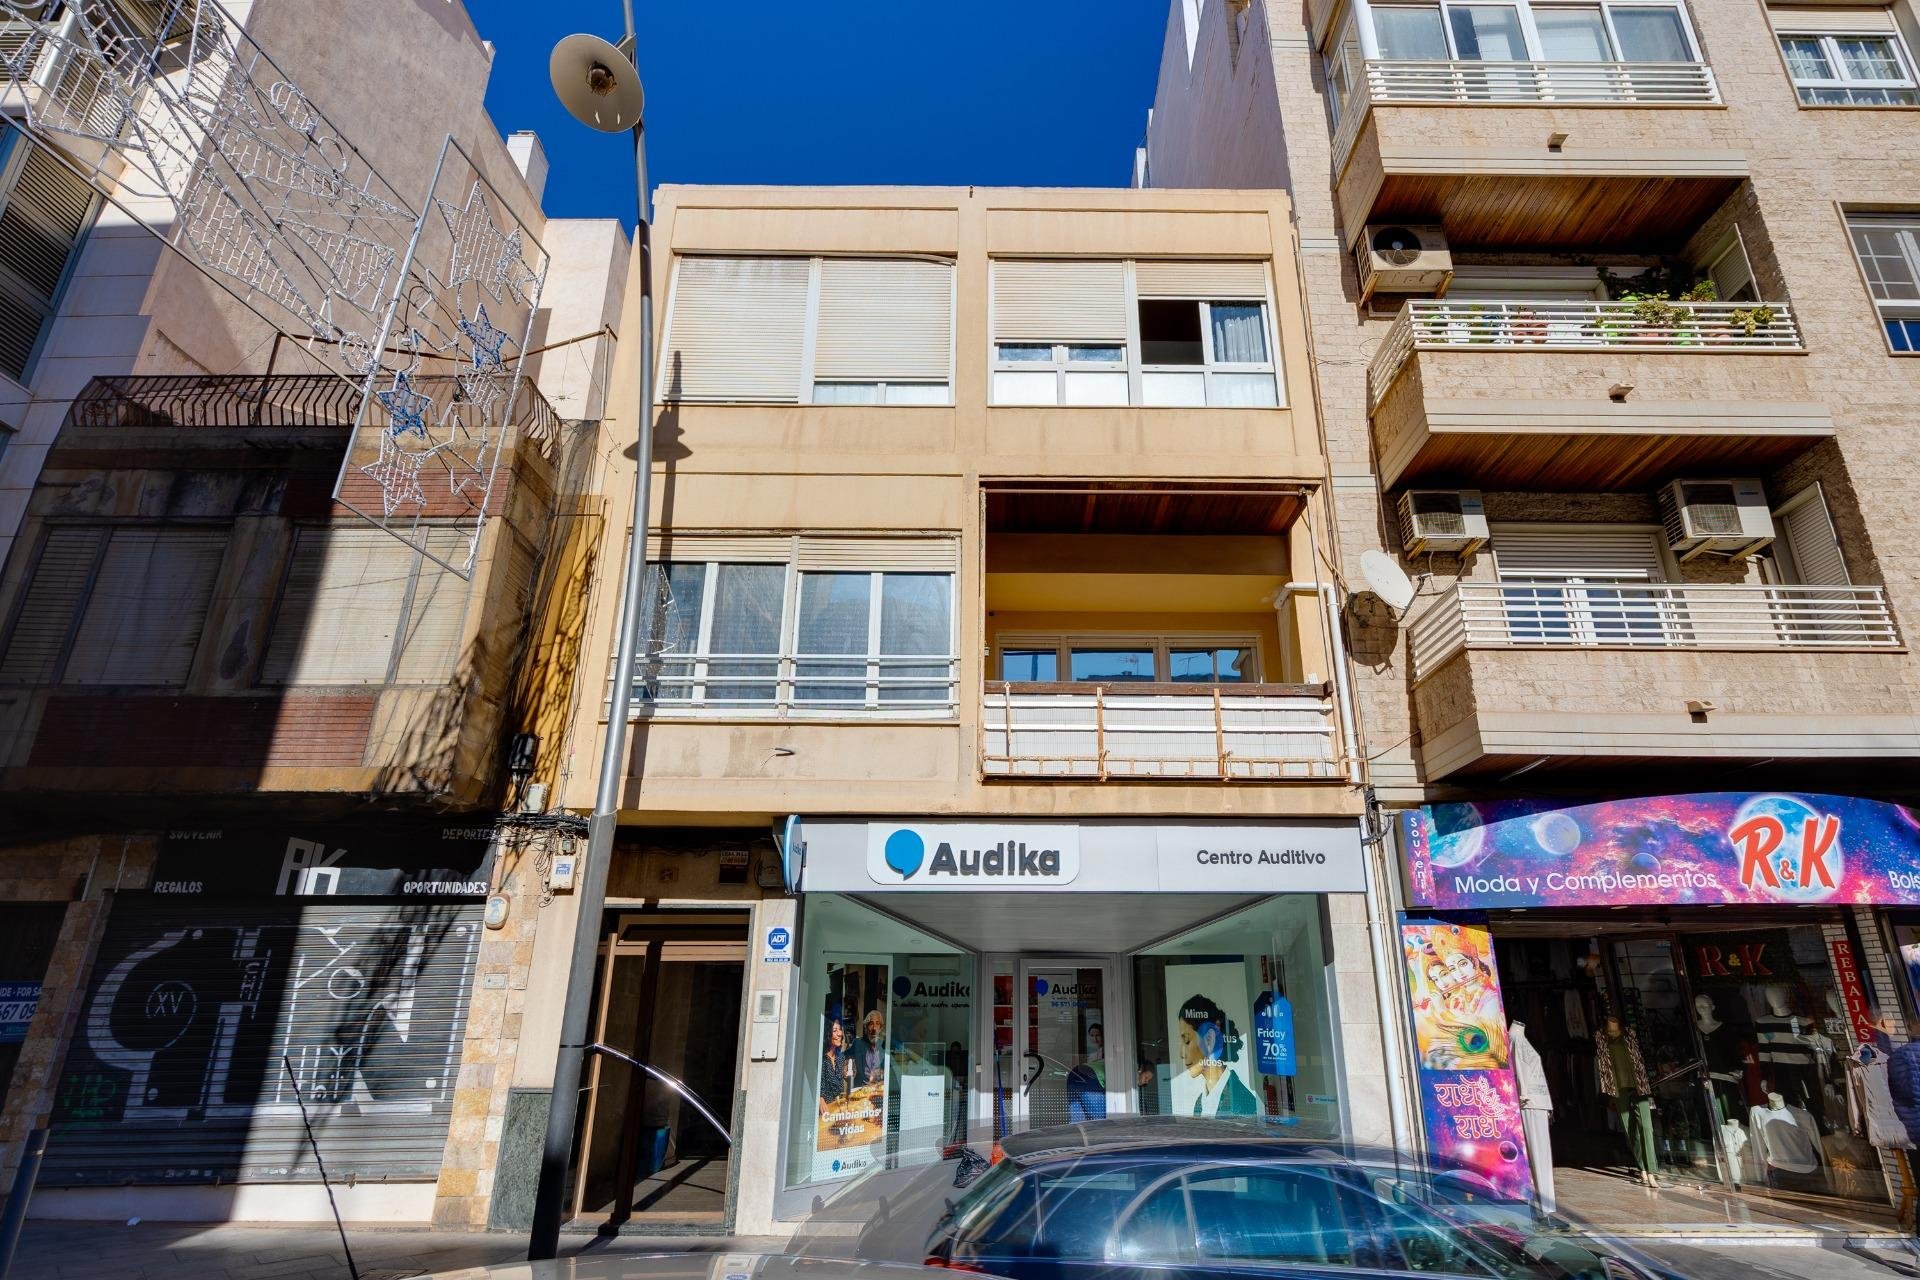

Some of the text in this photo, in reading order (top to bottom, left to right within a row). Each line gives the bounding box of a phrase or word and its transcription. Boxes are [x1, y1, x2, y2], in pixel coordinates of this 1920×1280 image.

[929, 840, 1060, 874] Audika
[1196, 849, 1326, 865] Centro Auditivo
[1410, 817, 1426, 900] Souvenir
[154, 881, 203, 894] REGALOS
[403, 881, 487, 894] OPORTUNIDADES
[1455, 868, 1717, 895] Moda y Complementos
[771, 935, 785, 943] ADT
[17, 987, 31, 997] FOR
[1836, 943, 1871, 1040] REBAJAS
[1185, 1009, 1209, 1019] Mima
[1222, 1034, 1237, 1043] tus
[1257, 1028, 1286, 1041] Friday
[822, 1108, 880, 1122] Cambiamos
[839, 1123, 865, 1136] vidas
